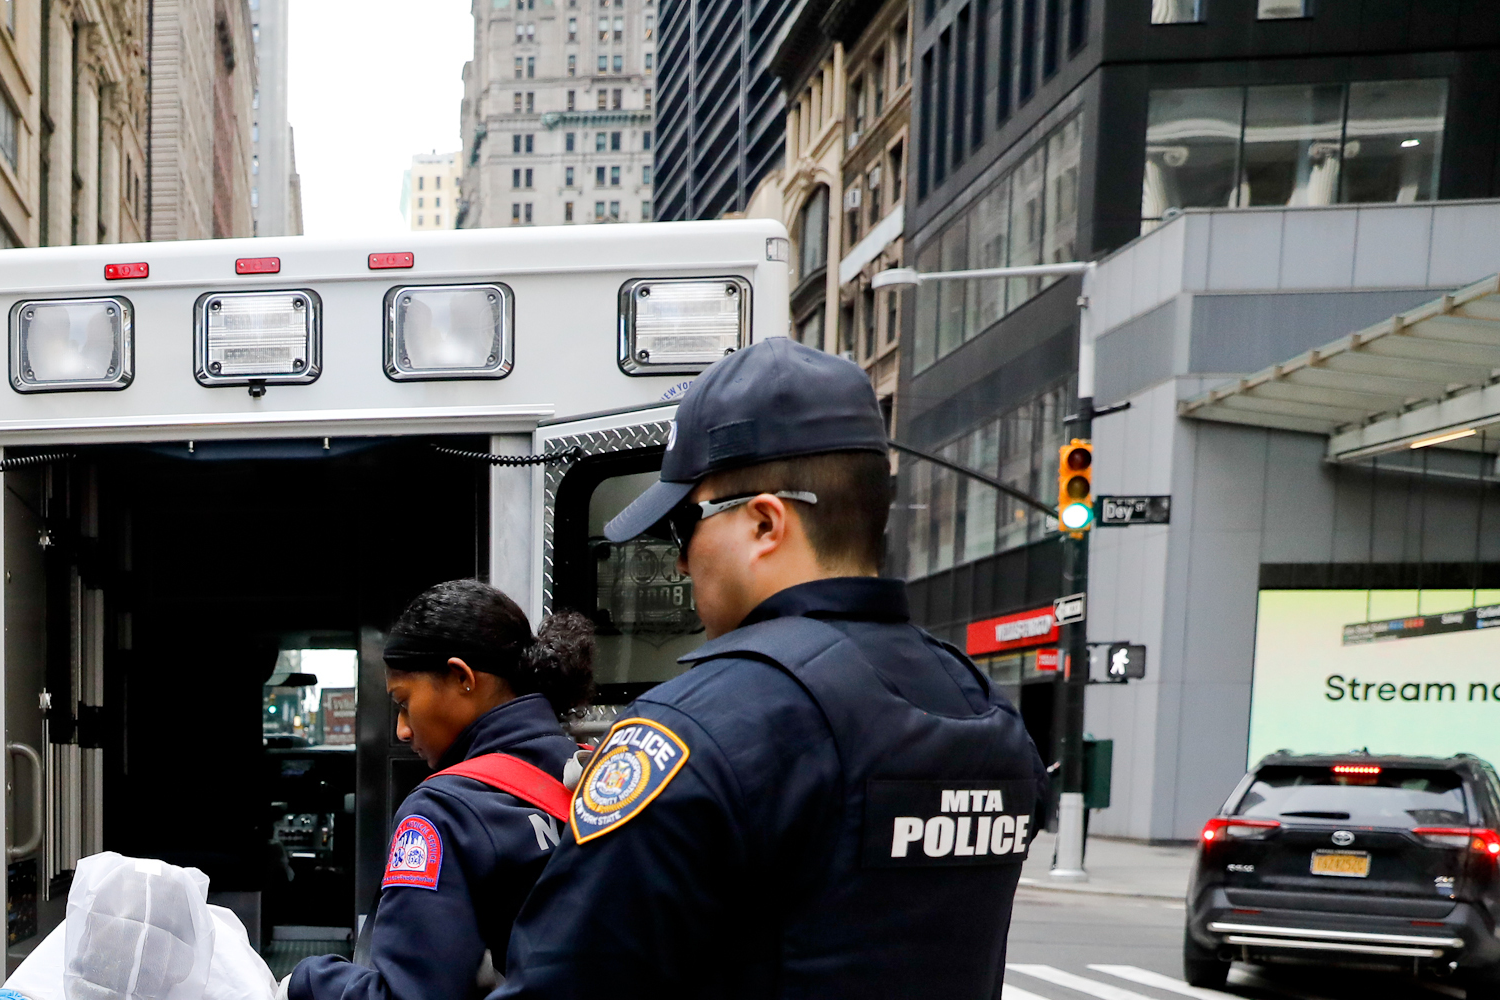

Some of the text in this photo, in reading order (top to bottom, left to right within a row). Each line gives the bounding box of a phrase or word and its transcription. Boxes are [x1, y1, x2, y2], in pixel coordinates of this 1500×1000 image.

[1106, 503, 1134, 522] Dey
[1325, 674, 1456, 701] Stream
[602, 727, 676, 772] POLICE
[940, 789, 1004, 813] MTA
[427, 834, 437, 864] SERVICE
[890, 815, 1030, 858] POLICE
